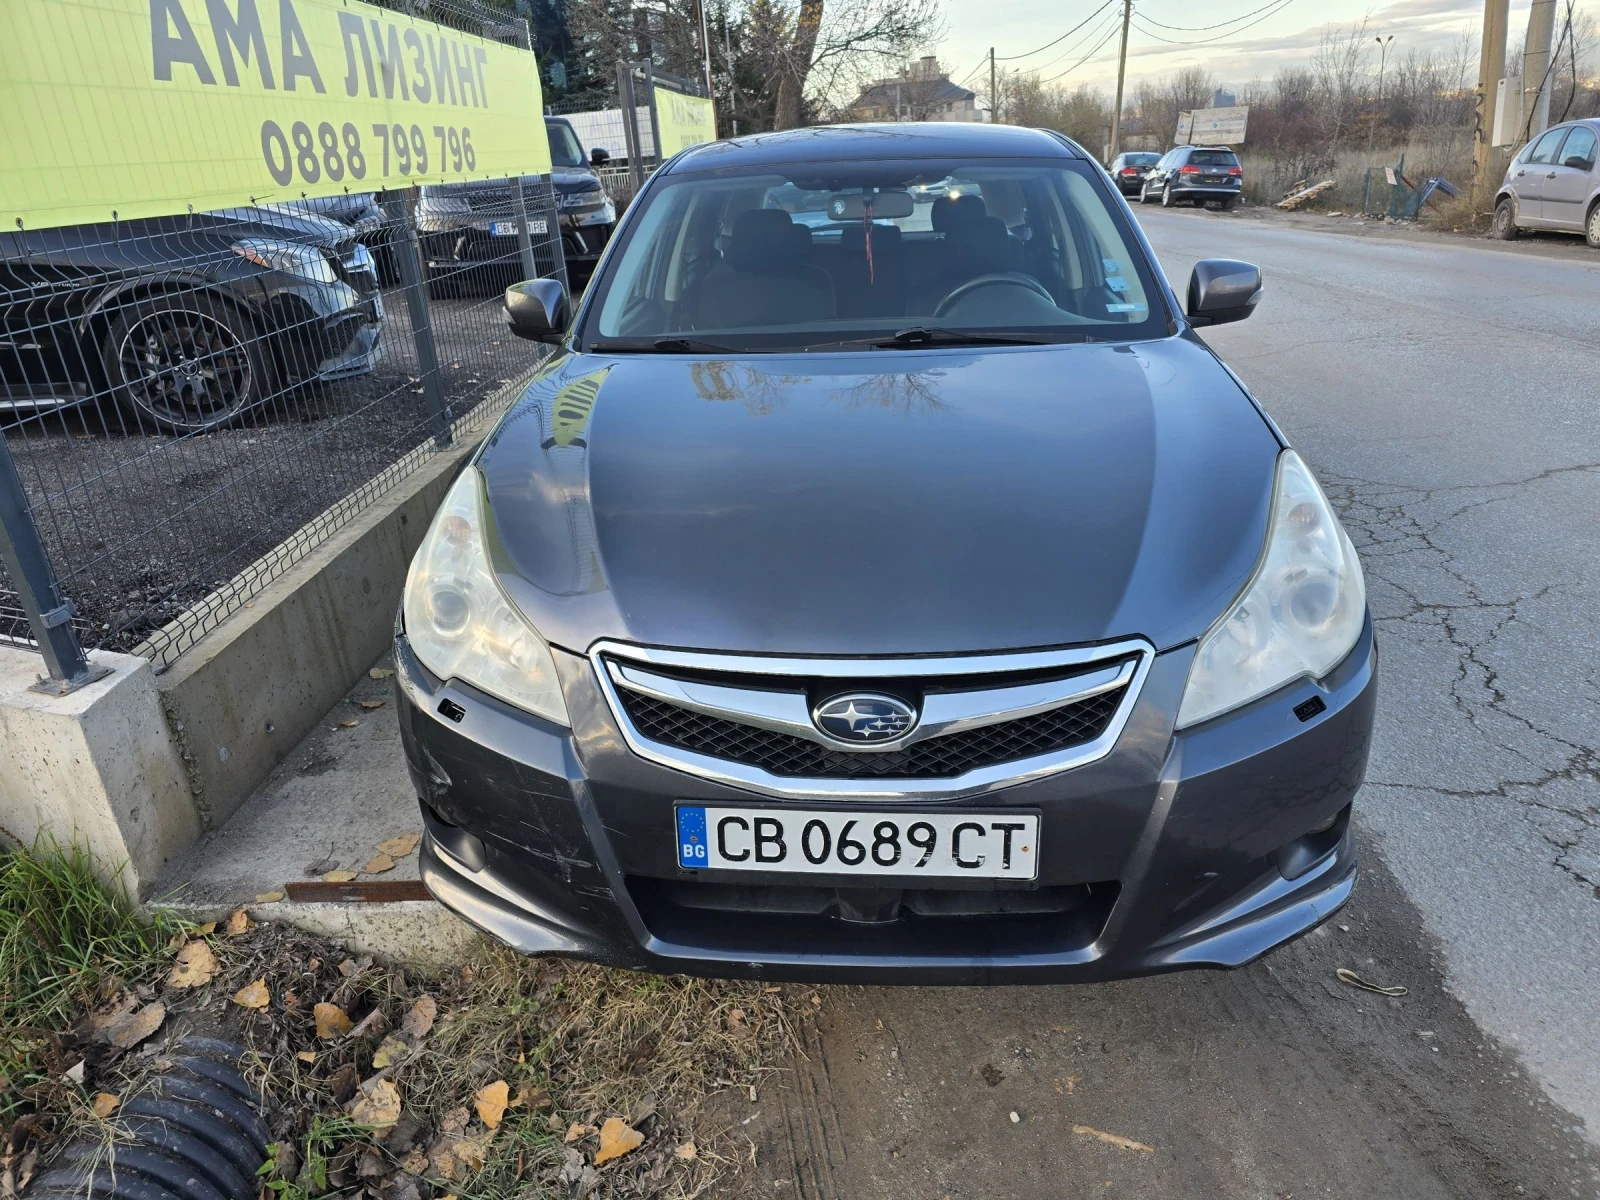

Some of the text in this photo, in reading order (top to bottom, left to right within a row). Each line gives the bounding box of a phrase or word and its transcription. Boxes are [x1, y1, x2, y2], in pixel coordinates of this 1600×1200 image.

[150, 0, 488, 109] АМА ЛИЗИНГ
[261, 120, 476, 187] 0888 799 796
[683, 844, 705, 859] BG
[717, 816, 1026, 870] CB 0689 CT
